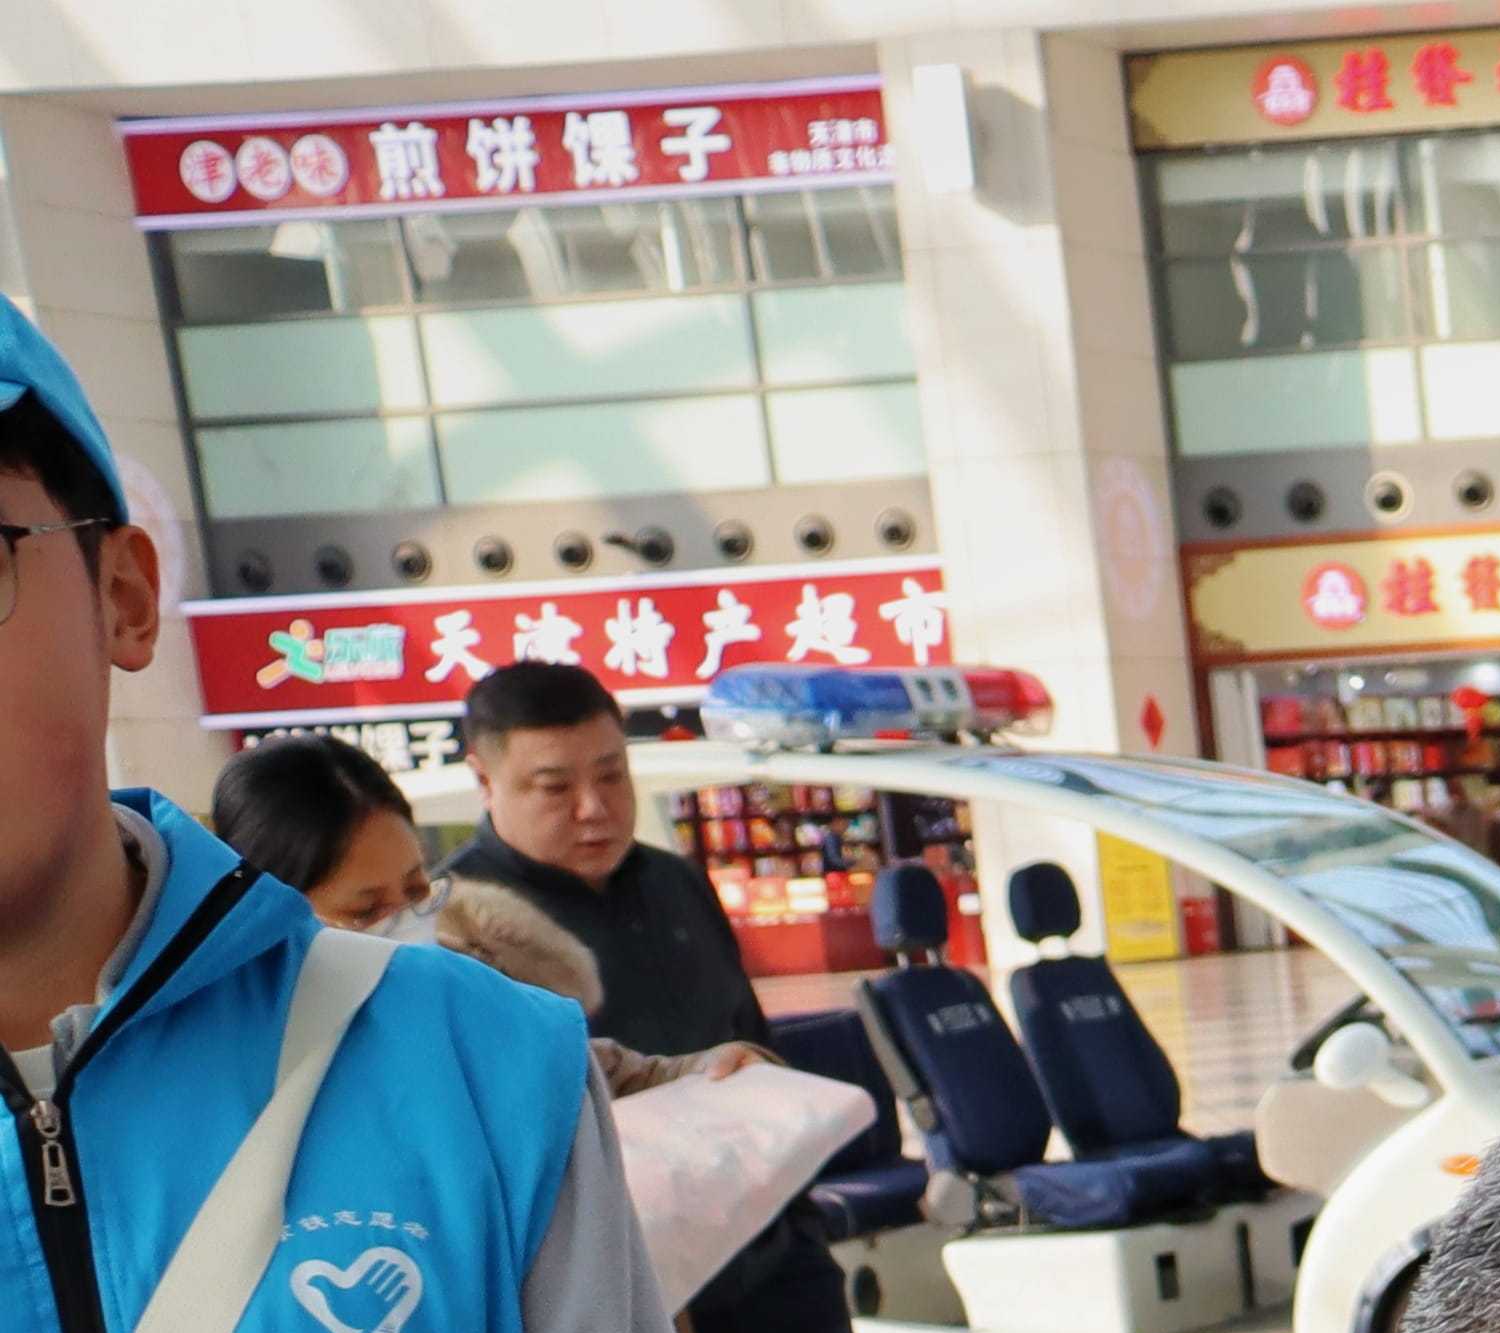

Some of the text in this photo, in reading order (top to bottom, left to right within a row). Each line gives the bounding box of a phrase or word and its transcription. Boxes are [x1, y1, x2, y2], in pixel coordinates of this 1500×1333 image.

[424, 577, 944, 683] 天津特产超市
